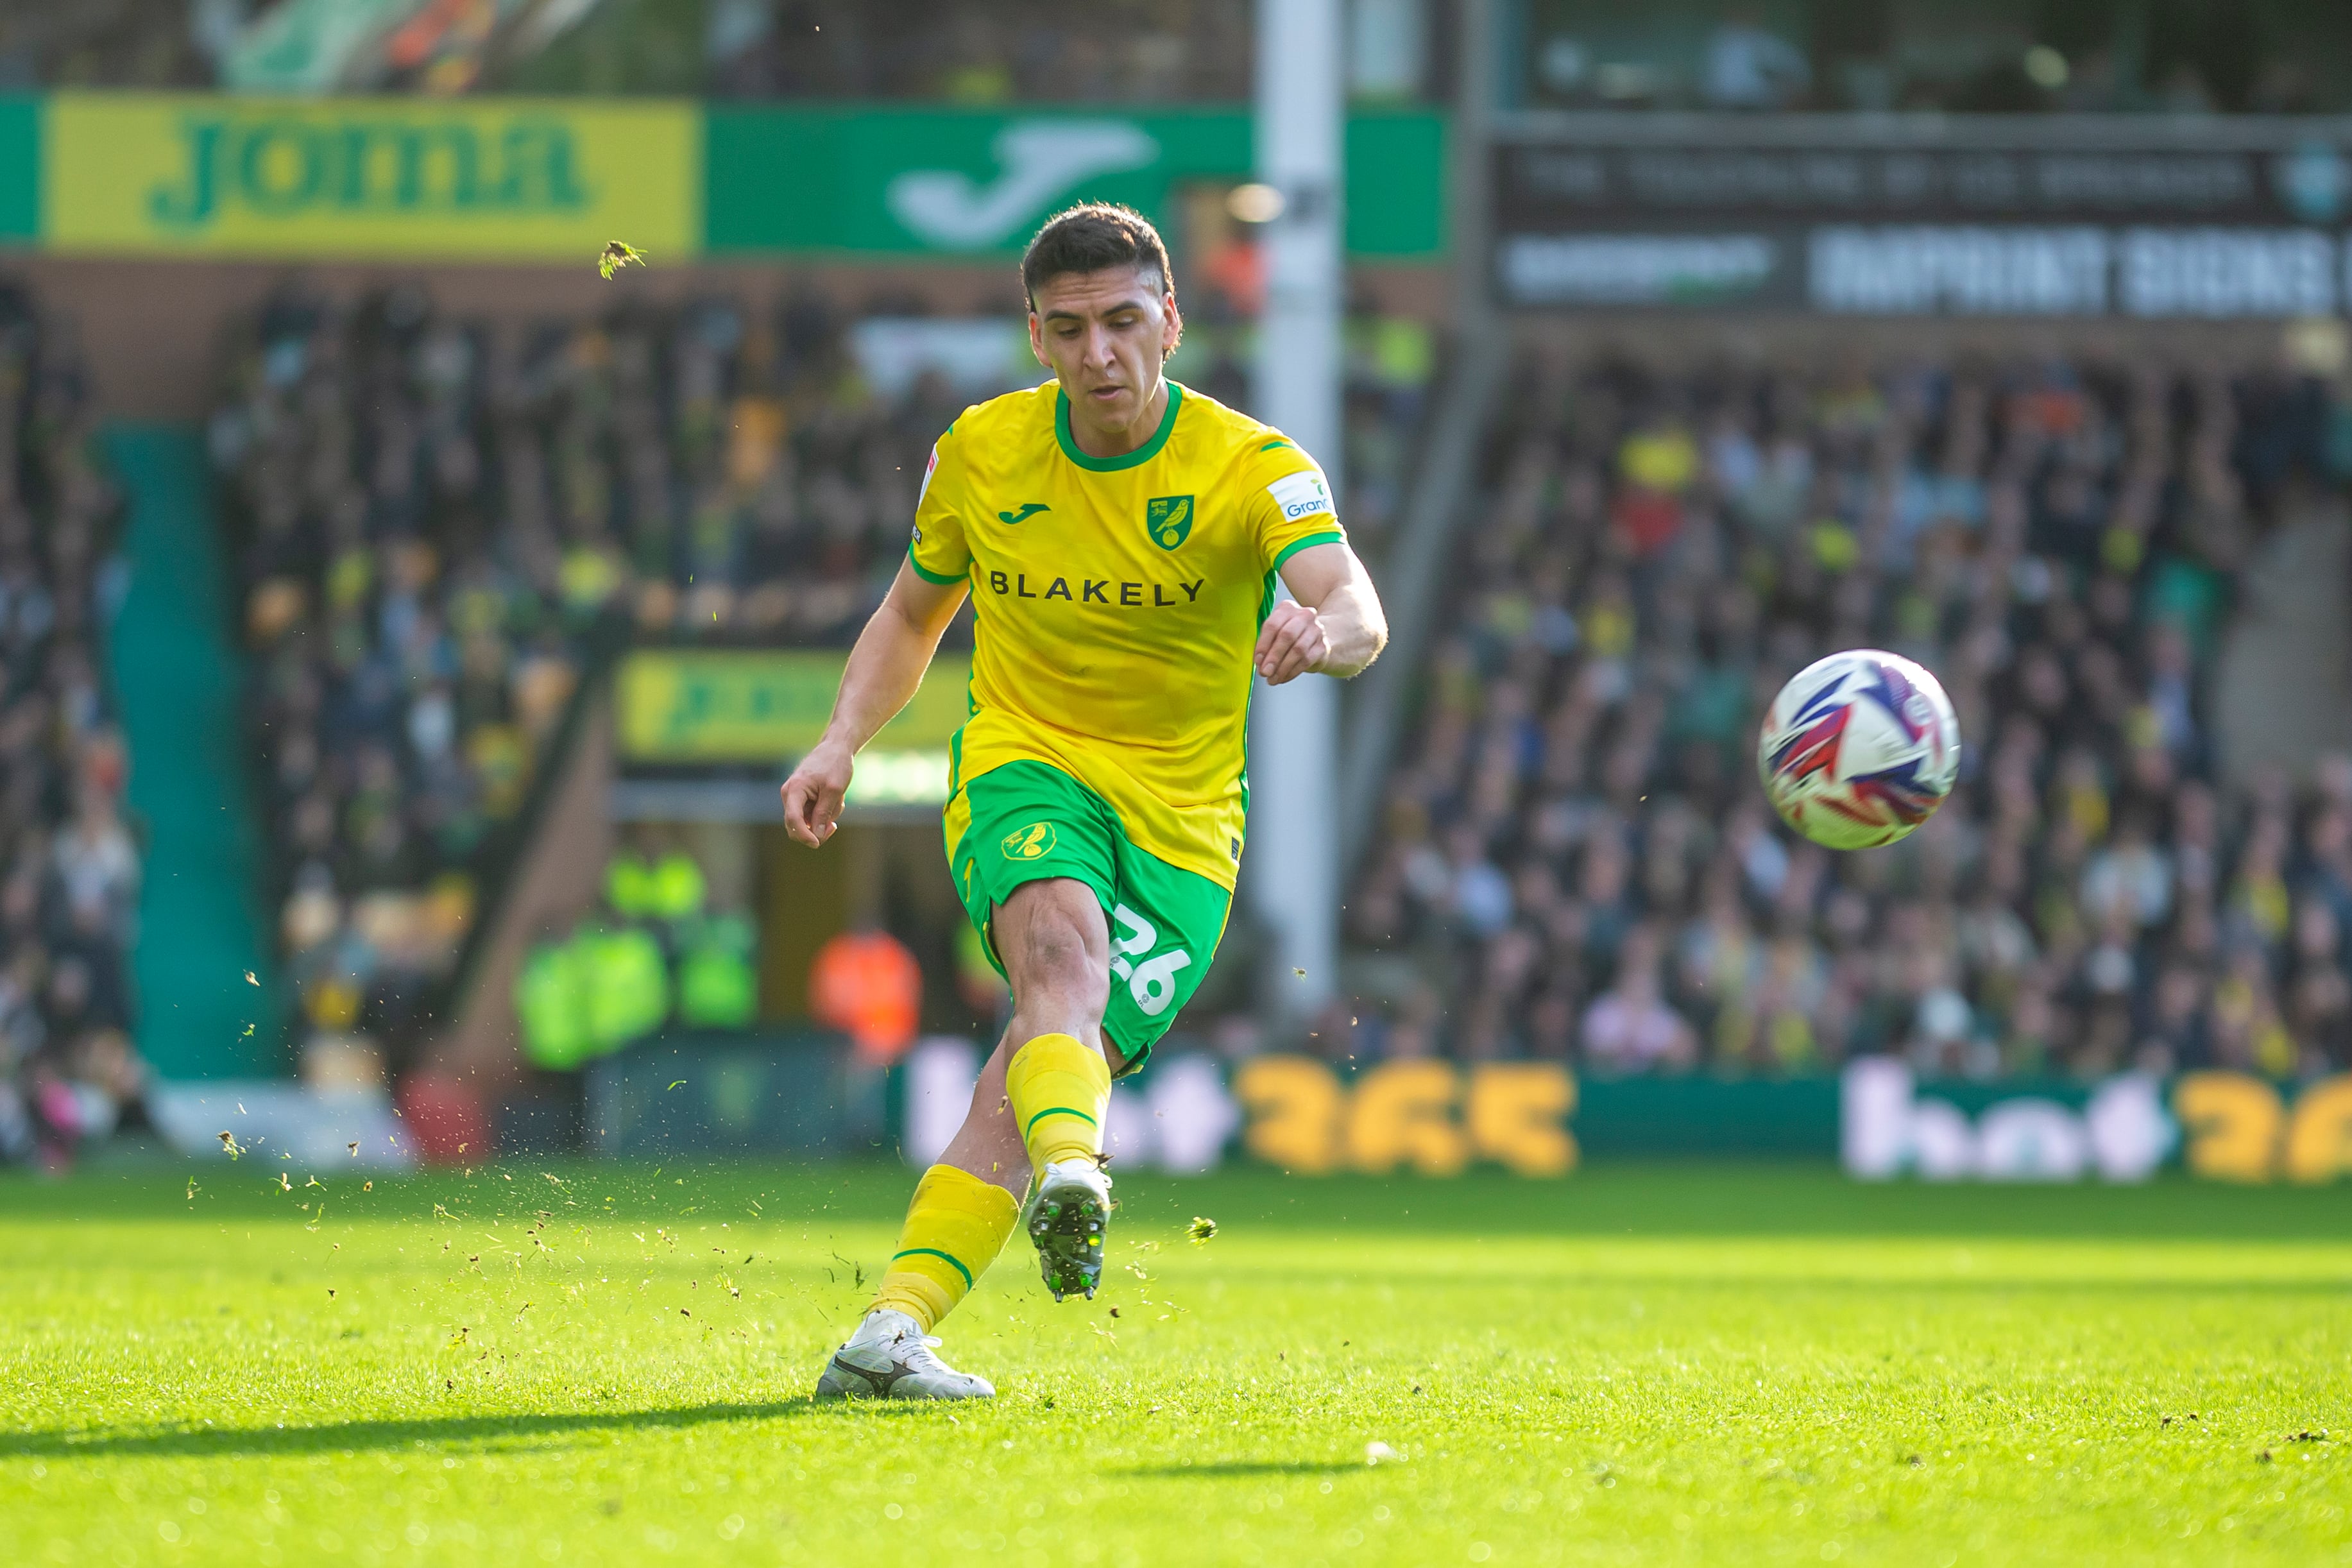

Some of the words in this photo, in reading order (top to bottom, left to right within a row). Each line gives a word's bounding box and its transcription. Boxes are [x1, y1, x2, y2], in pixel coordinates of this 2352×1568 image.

[991, 571, 1205, 607] BLAKELY
[1109, 903, 1192, 1016] 26
[903, 1044, 1578, 1175] t365
